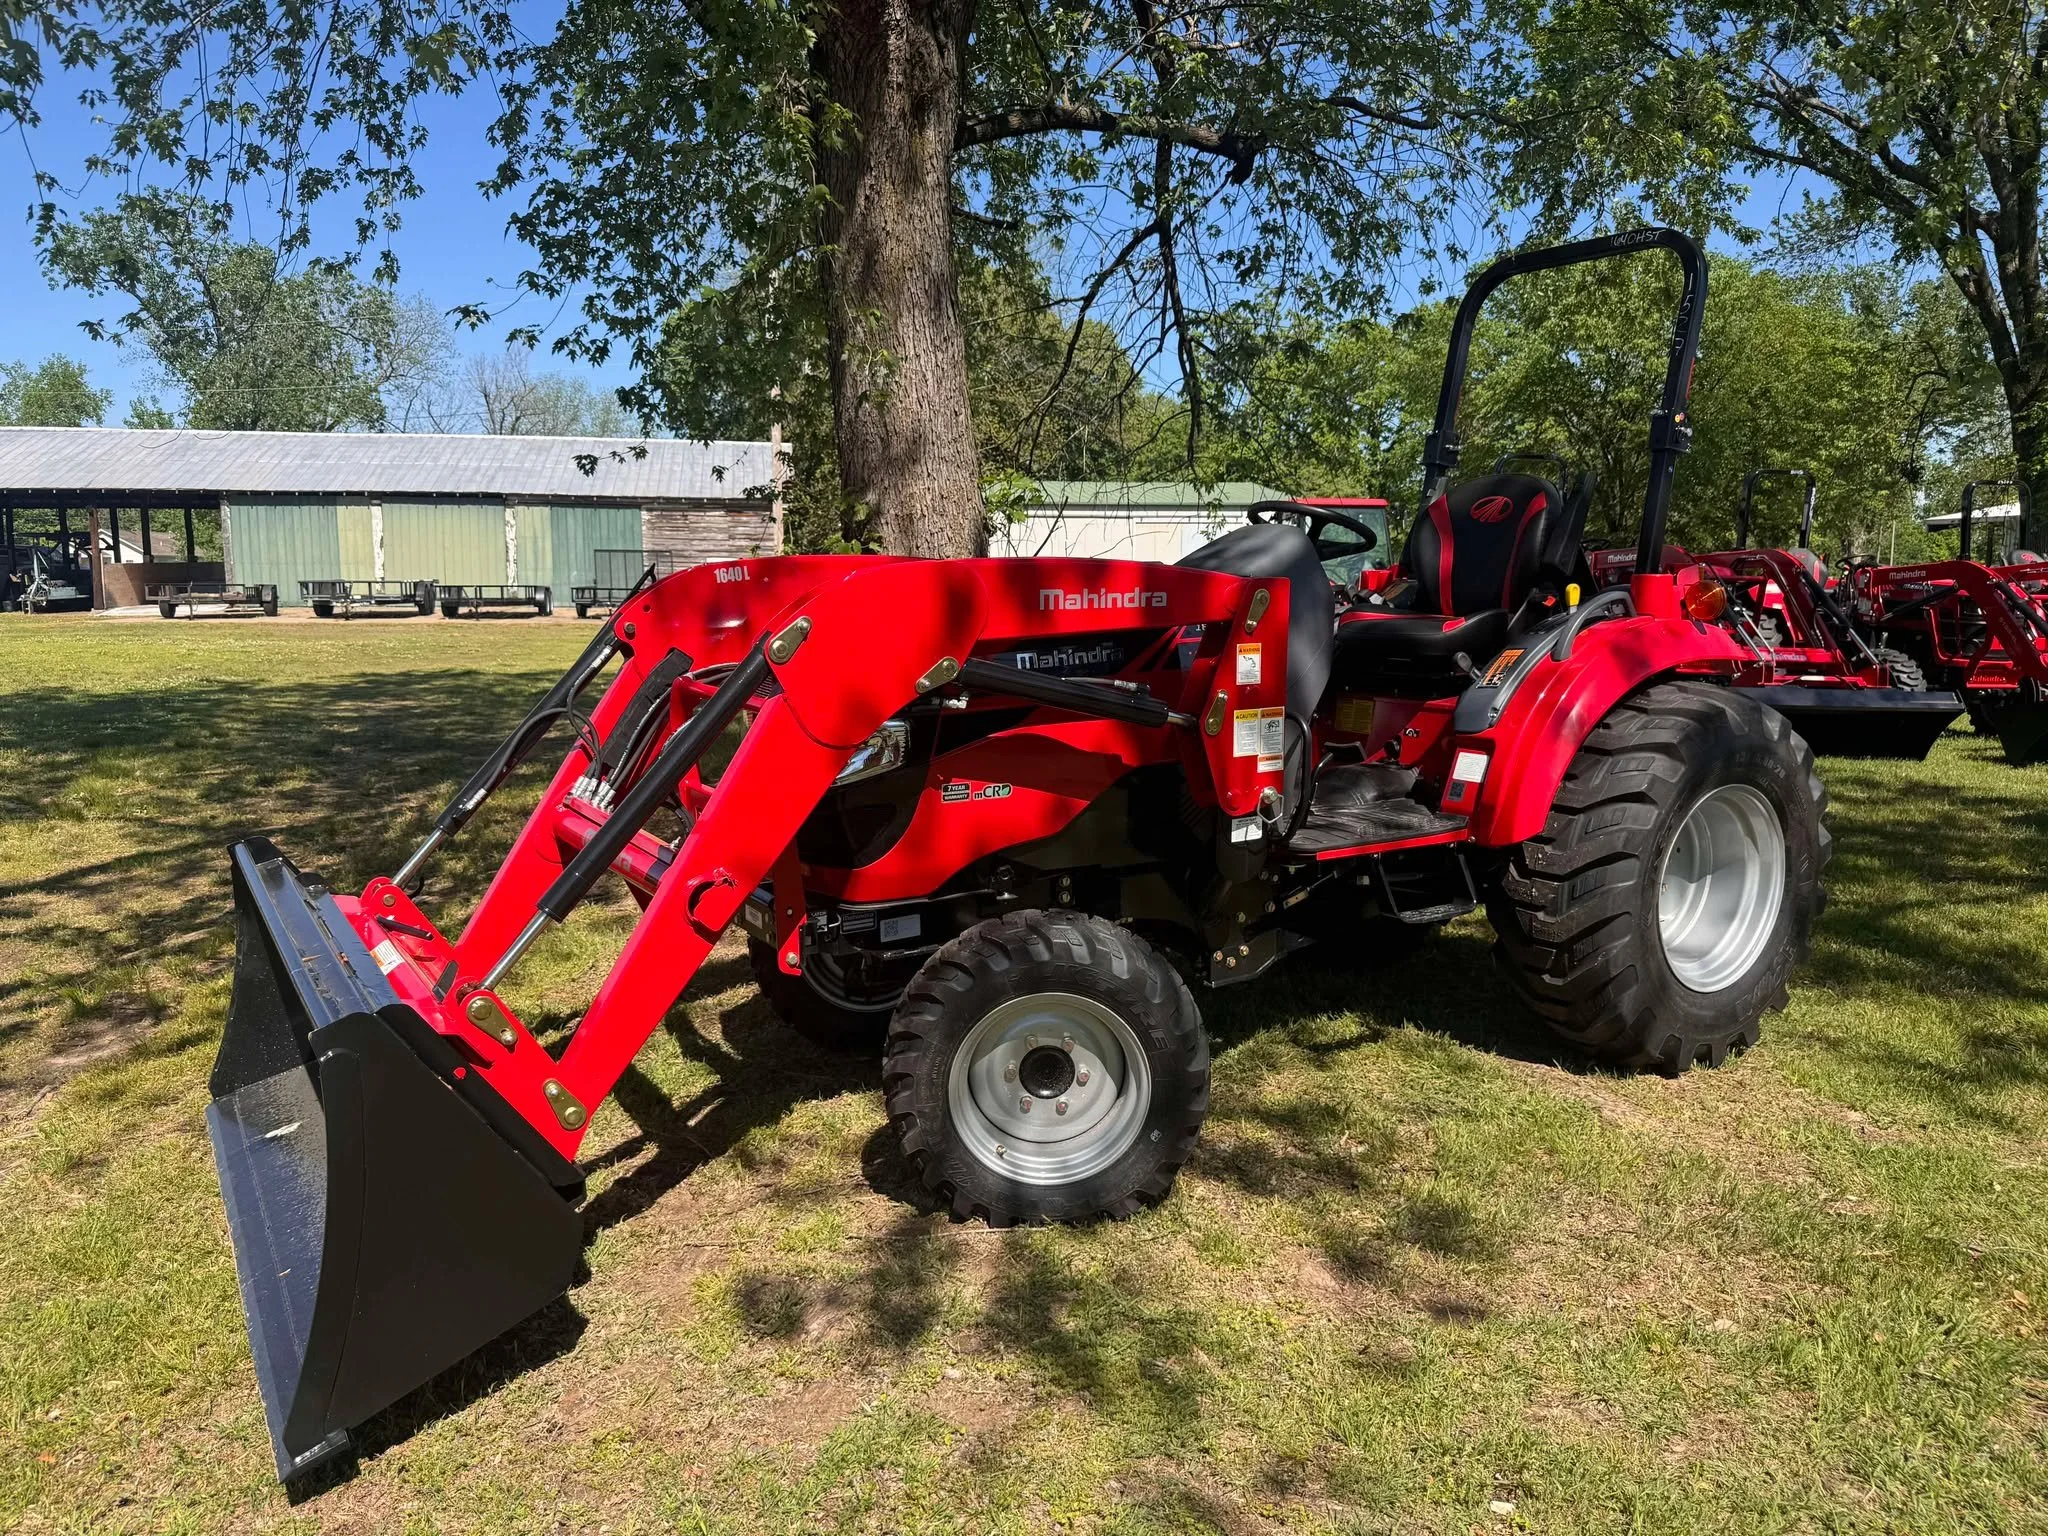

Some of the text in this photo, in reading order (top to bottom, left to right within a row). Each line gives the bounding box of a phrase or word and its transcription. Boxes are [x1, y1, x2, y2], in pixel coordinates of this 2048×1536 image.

[713, 565, 751, 584] 1640 L
[1889, 569, 1926, 580] Mahindra
[1039, 587, 1168, 611] Mahindra
[1016, 645, 1124, 670] Mahindra
[1240, 711, 1258, 720] CAUTION
